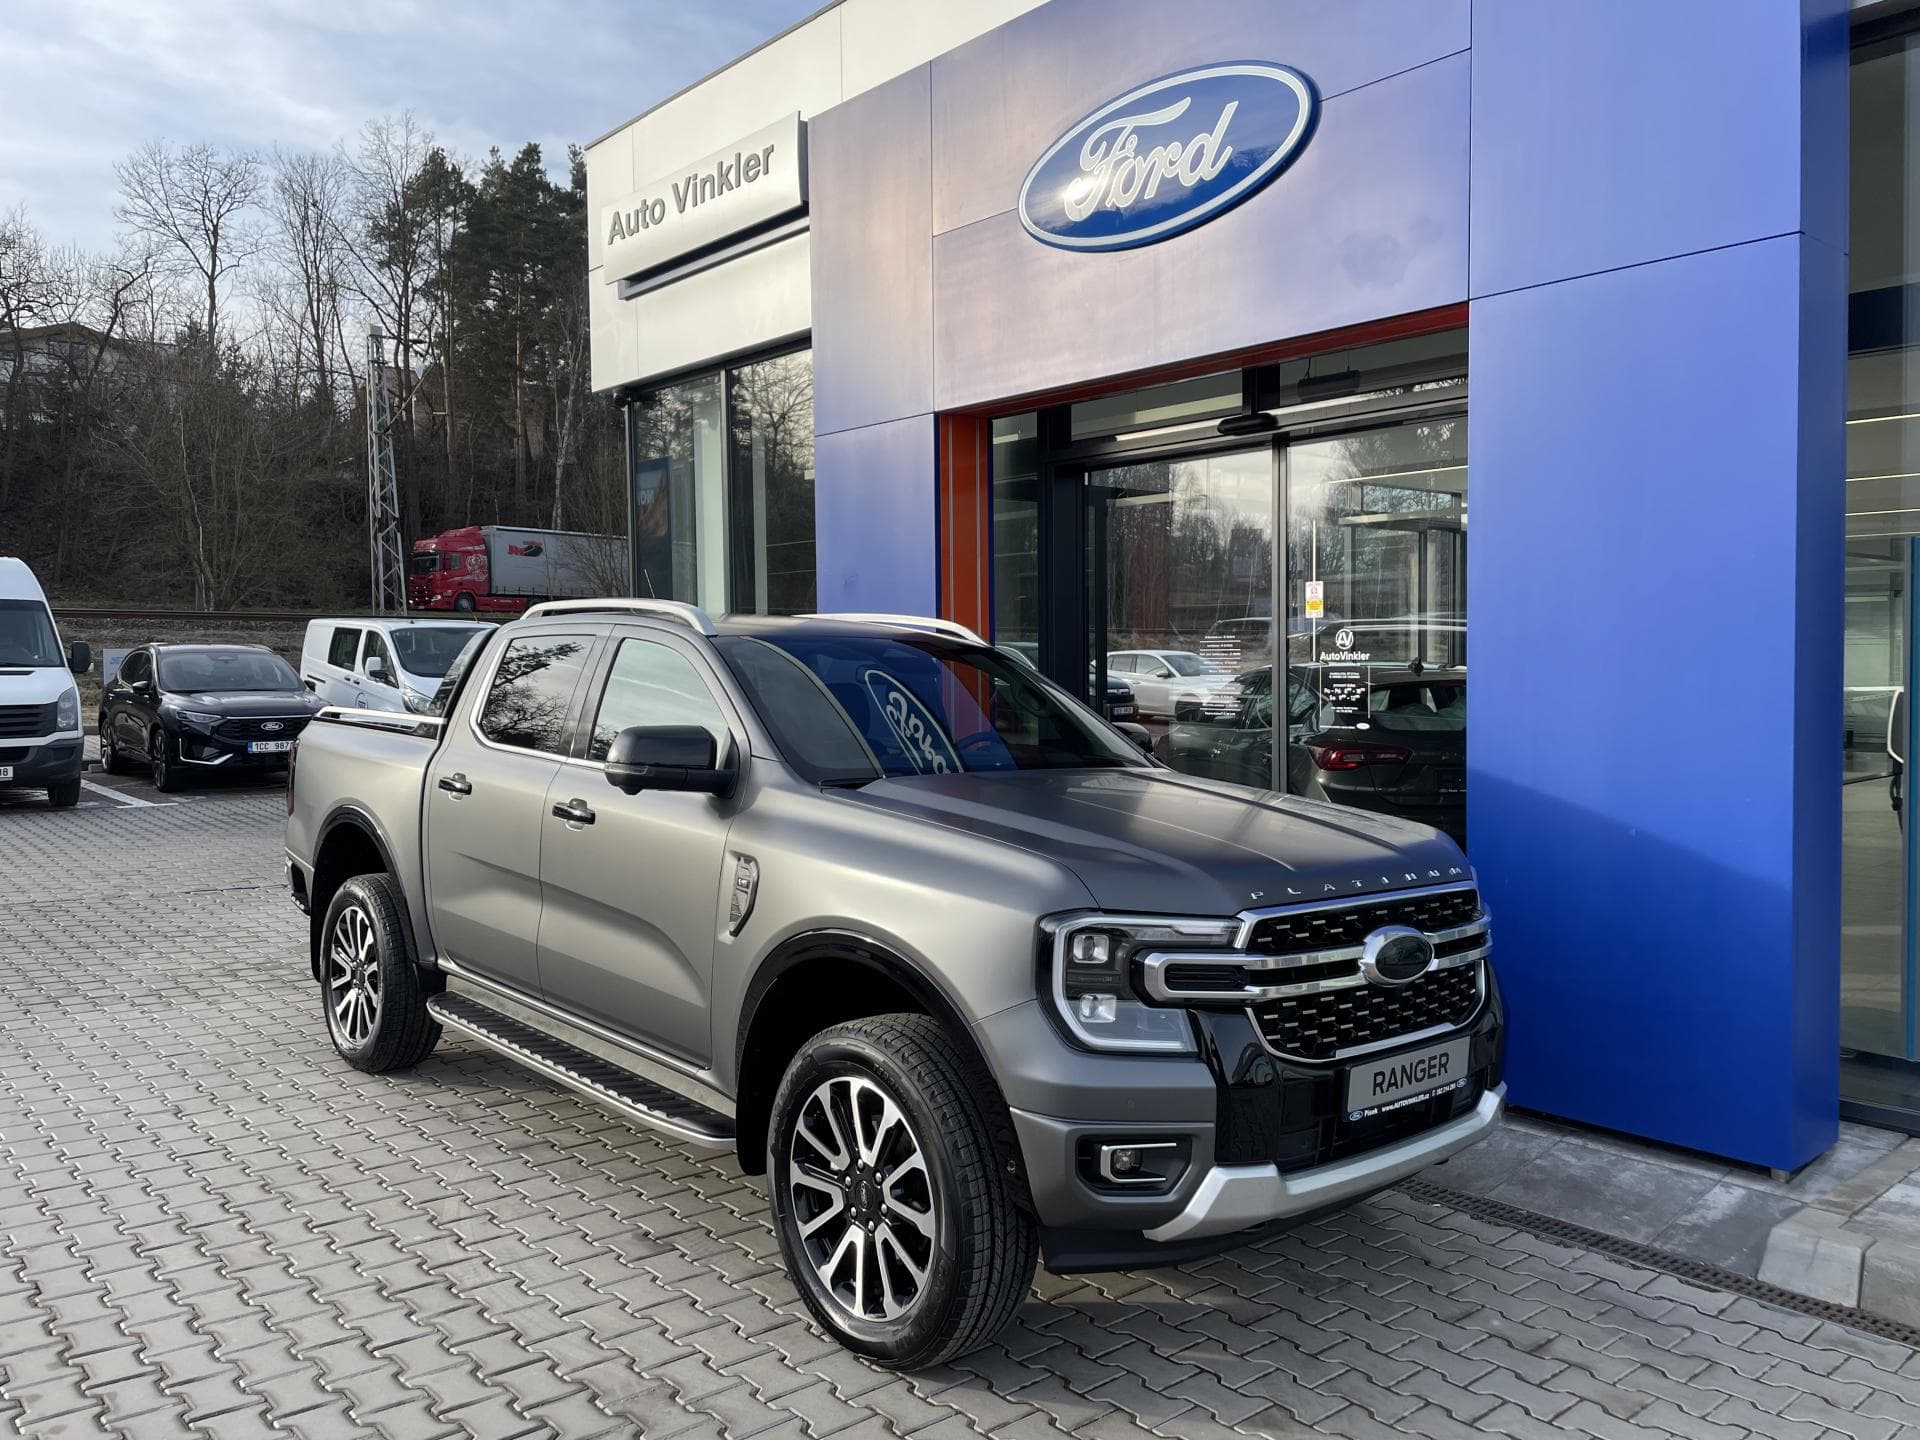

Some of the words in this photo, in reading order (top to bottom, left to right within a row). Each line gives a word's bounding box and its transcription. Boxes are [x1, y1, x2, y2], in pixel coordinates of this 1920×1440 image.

[1064, 97, 1239, 222] Ford
[608, 198, 666, 246] Auto
[672, 144, 775, 214] Vinkler
[1320, 651, 1370, 661] AutoVinkler
[255, 742, 270, 751] 1CC
[1250, 867, 1462, 900] PLATINUM
[1372, 1052, 1450, 1097] RANGER
